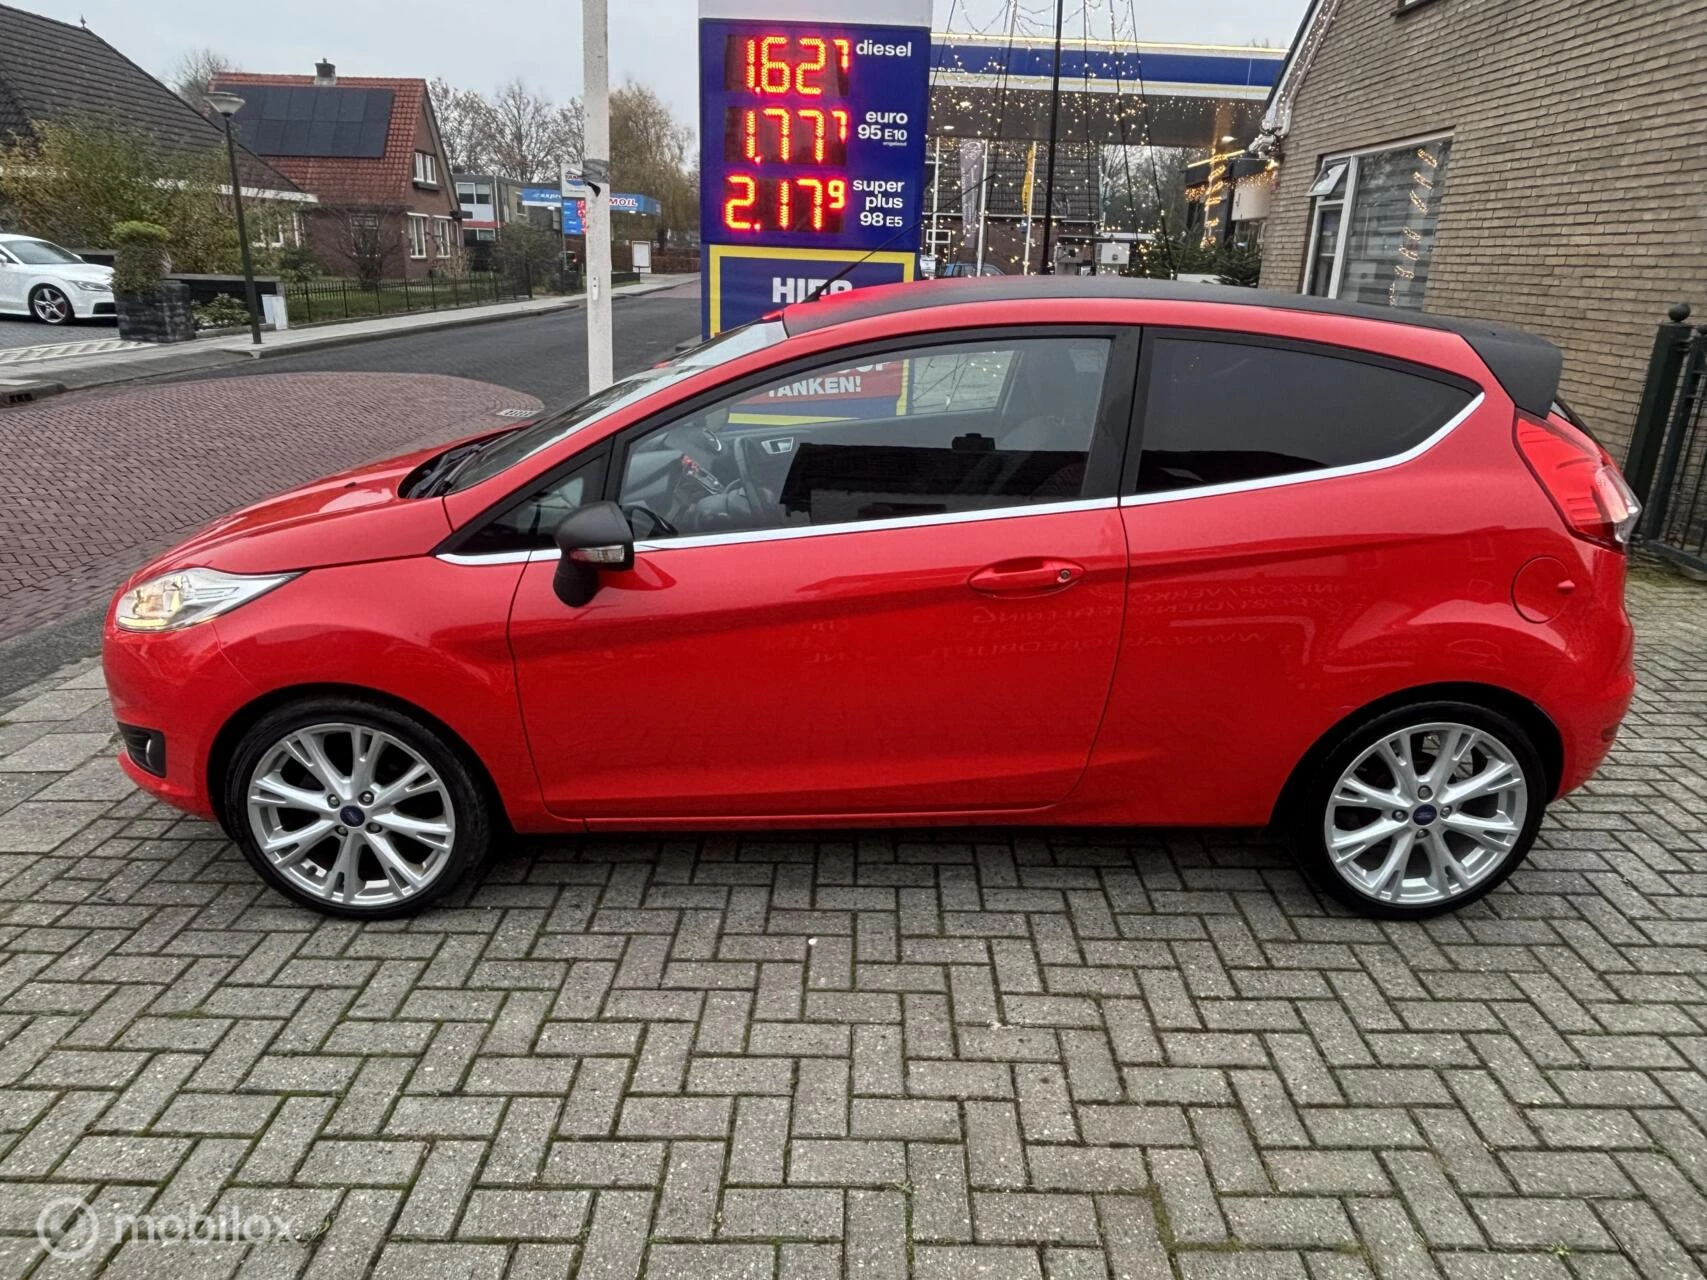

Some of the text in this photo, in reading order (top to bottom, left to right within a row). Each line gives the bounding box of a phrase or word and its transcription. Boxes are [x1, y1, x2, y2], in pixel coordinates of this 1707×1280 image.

[856, 40, 912, 57] diesel
[865, 111, 908, 124] euro
[857, 124, 908, 140] 95 E10
[852, 179, 905, 194] super
[865, 193, 903, 210] plus
[859, 211, 903, 227] 98 E5
